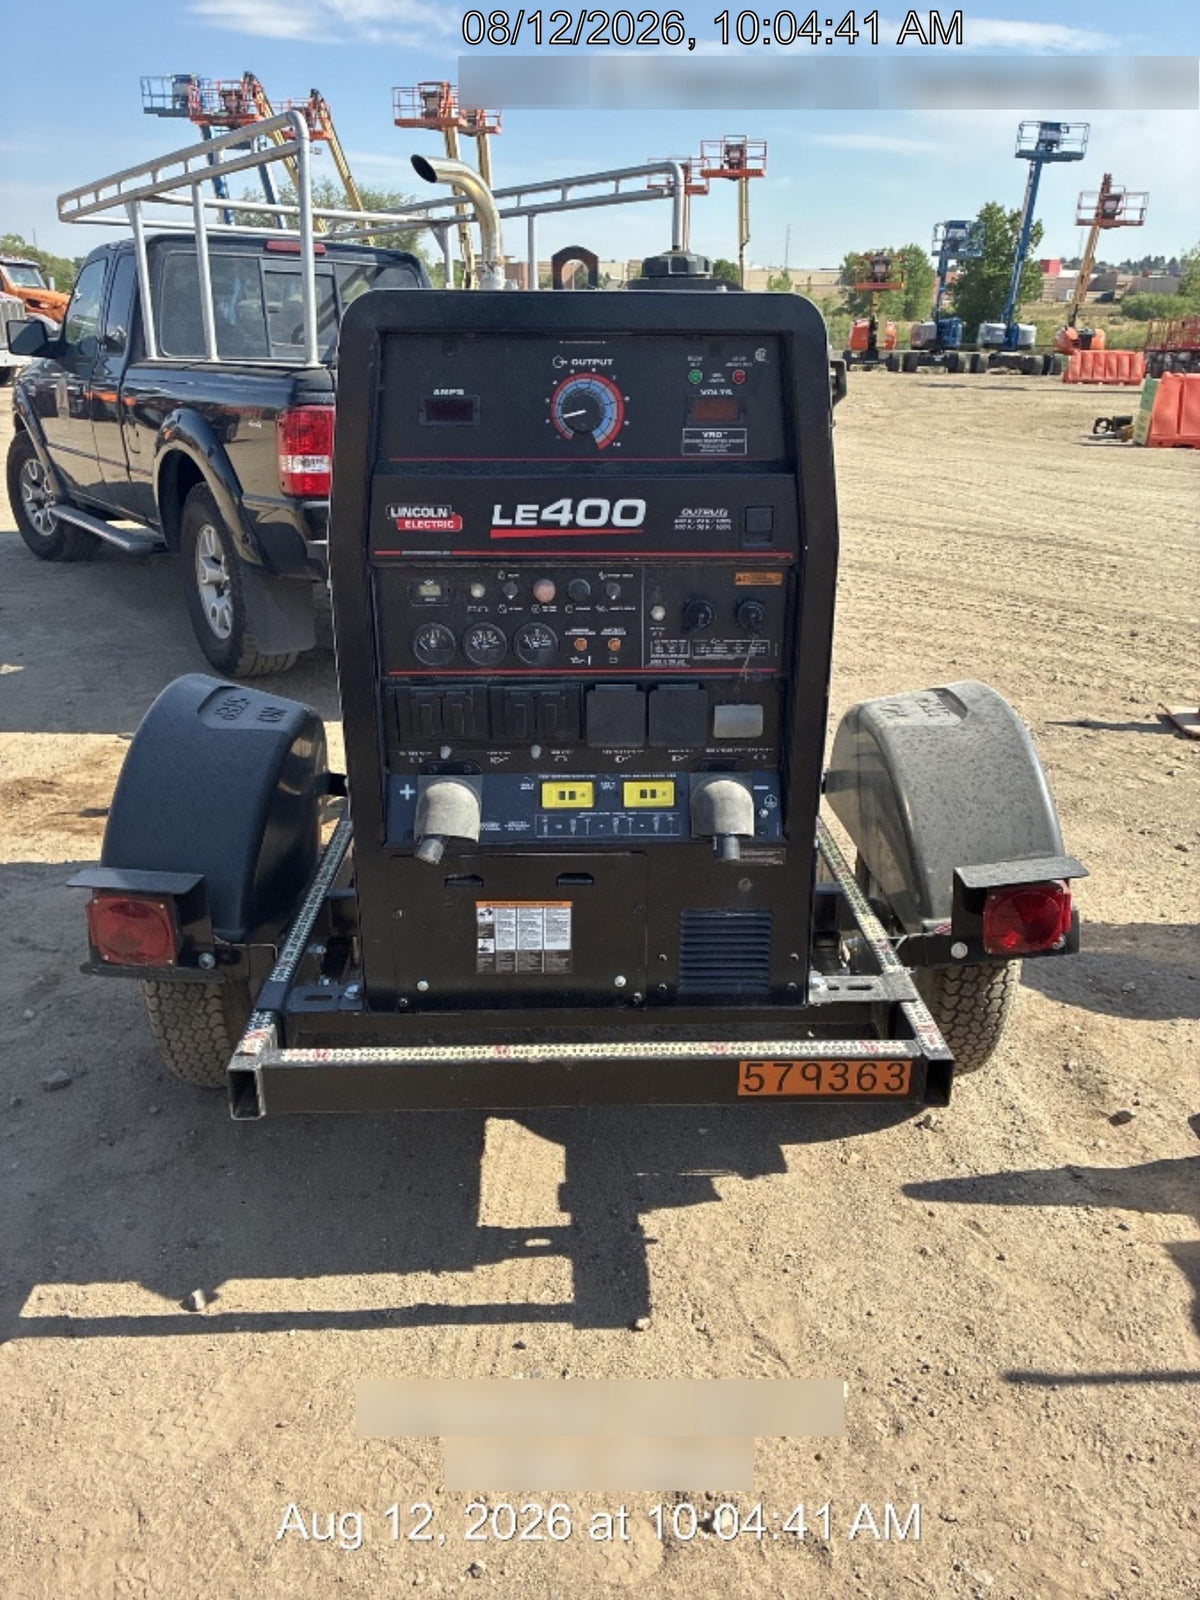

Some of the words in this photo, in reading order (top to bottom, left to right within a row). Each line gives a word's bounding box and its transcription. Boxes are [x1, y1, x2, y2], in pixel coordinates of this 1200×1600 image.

[571, 358, 613, 366] OUTPUT
[433, 388, 464, 396] AMPS
[700, 388, 733, 396] VOLTS
[390, 506, 449, 518] LINCOLN
[491, 498, 647, 528] LE400
[404, 520, 455, 529] ELECTRIC
[742, 1062, 905, 1093] 579363
